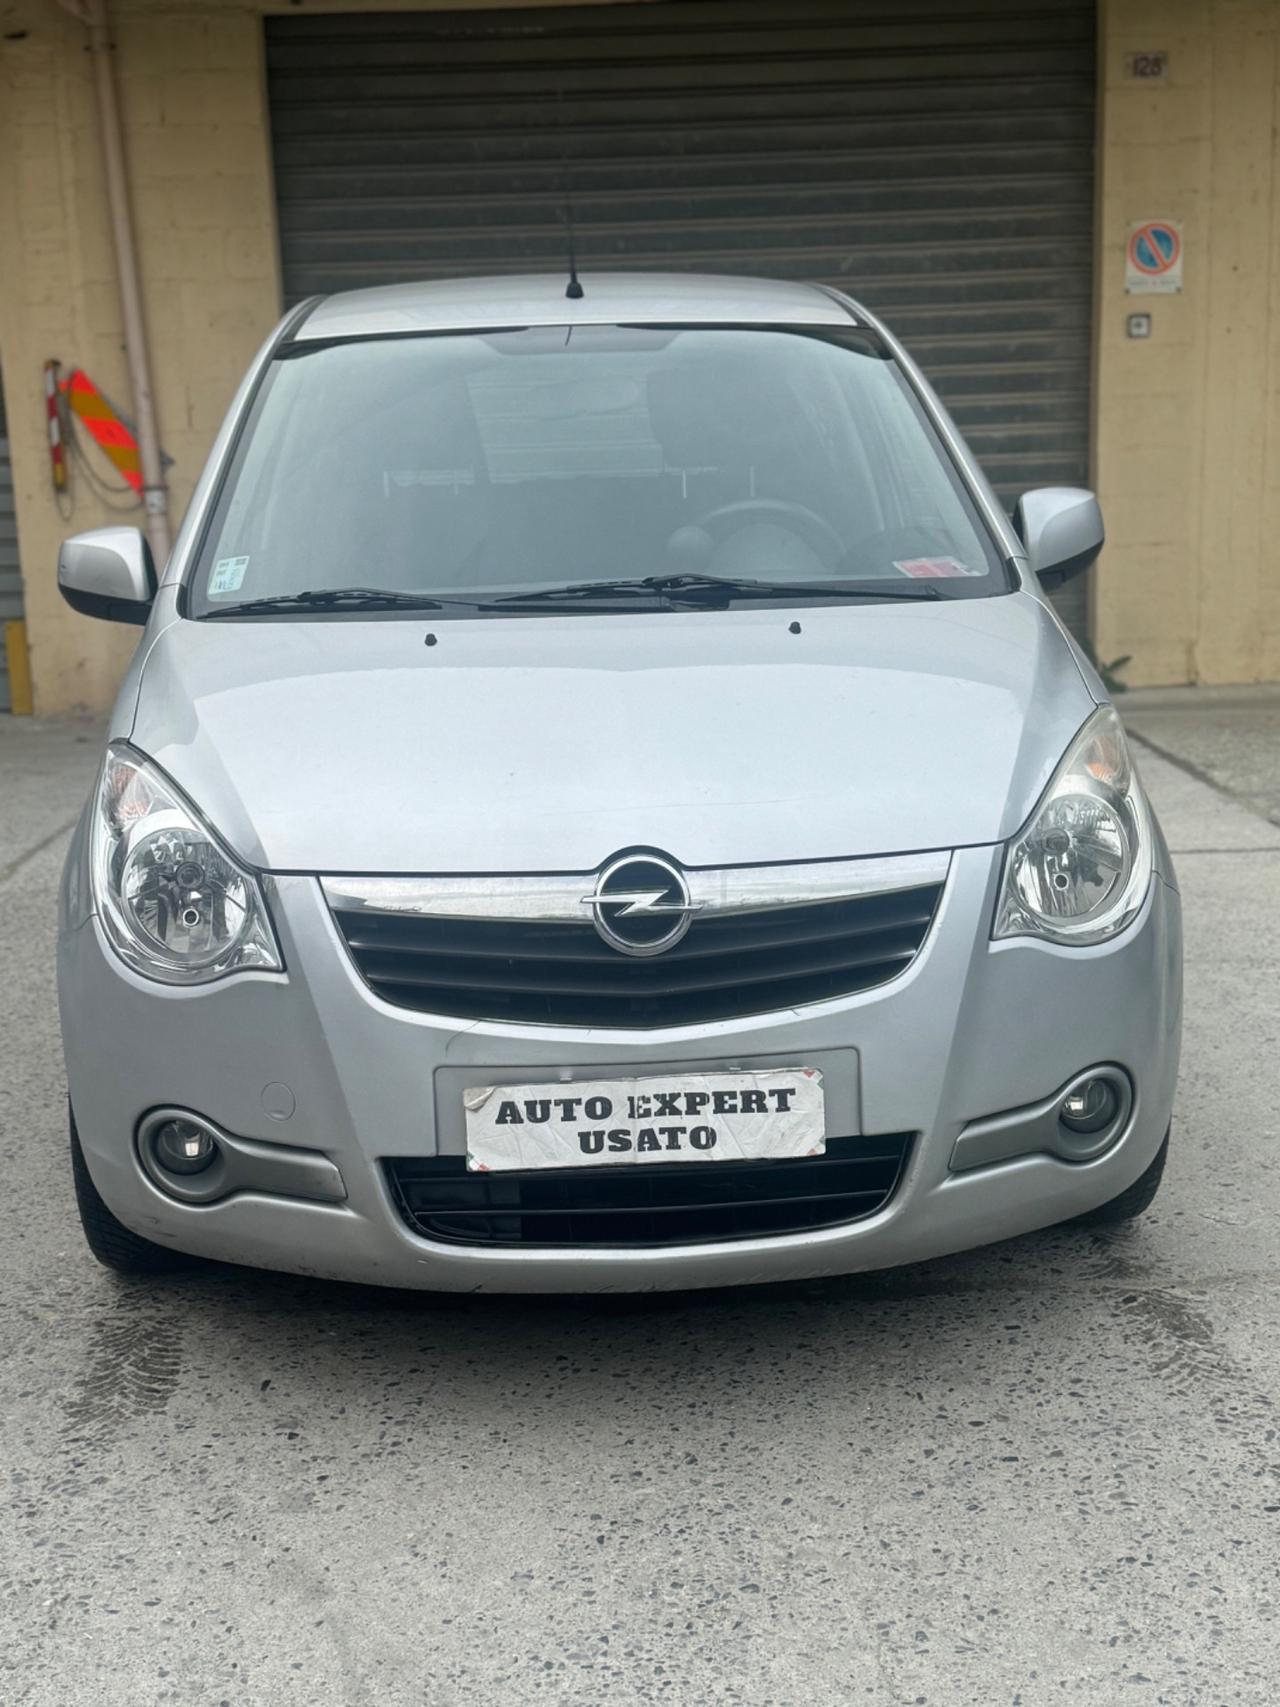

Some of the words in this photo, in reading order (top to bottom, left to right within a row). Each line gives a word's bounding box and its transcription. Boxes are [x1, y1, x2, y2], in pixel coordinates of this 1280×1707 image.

[495, 1096, 613, 1125] AUTO
[627, 1088, 796, 1119] EXPERT
[578, 1125, 717, 1154] USATO
